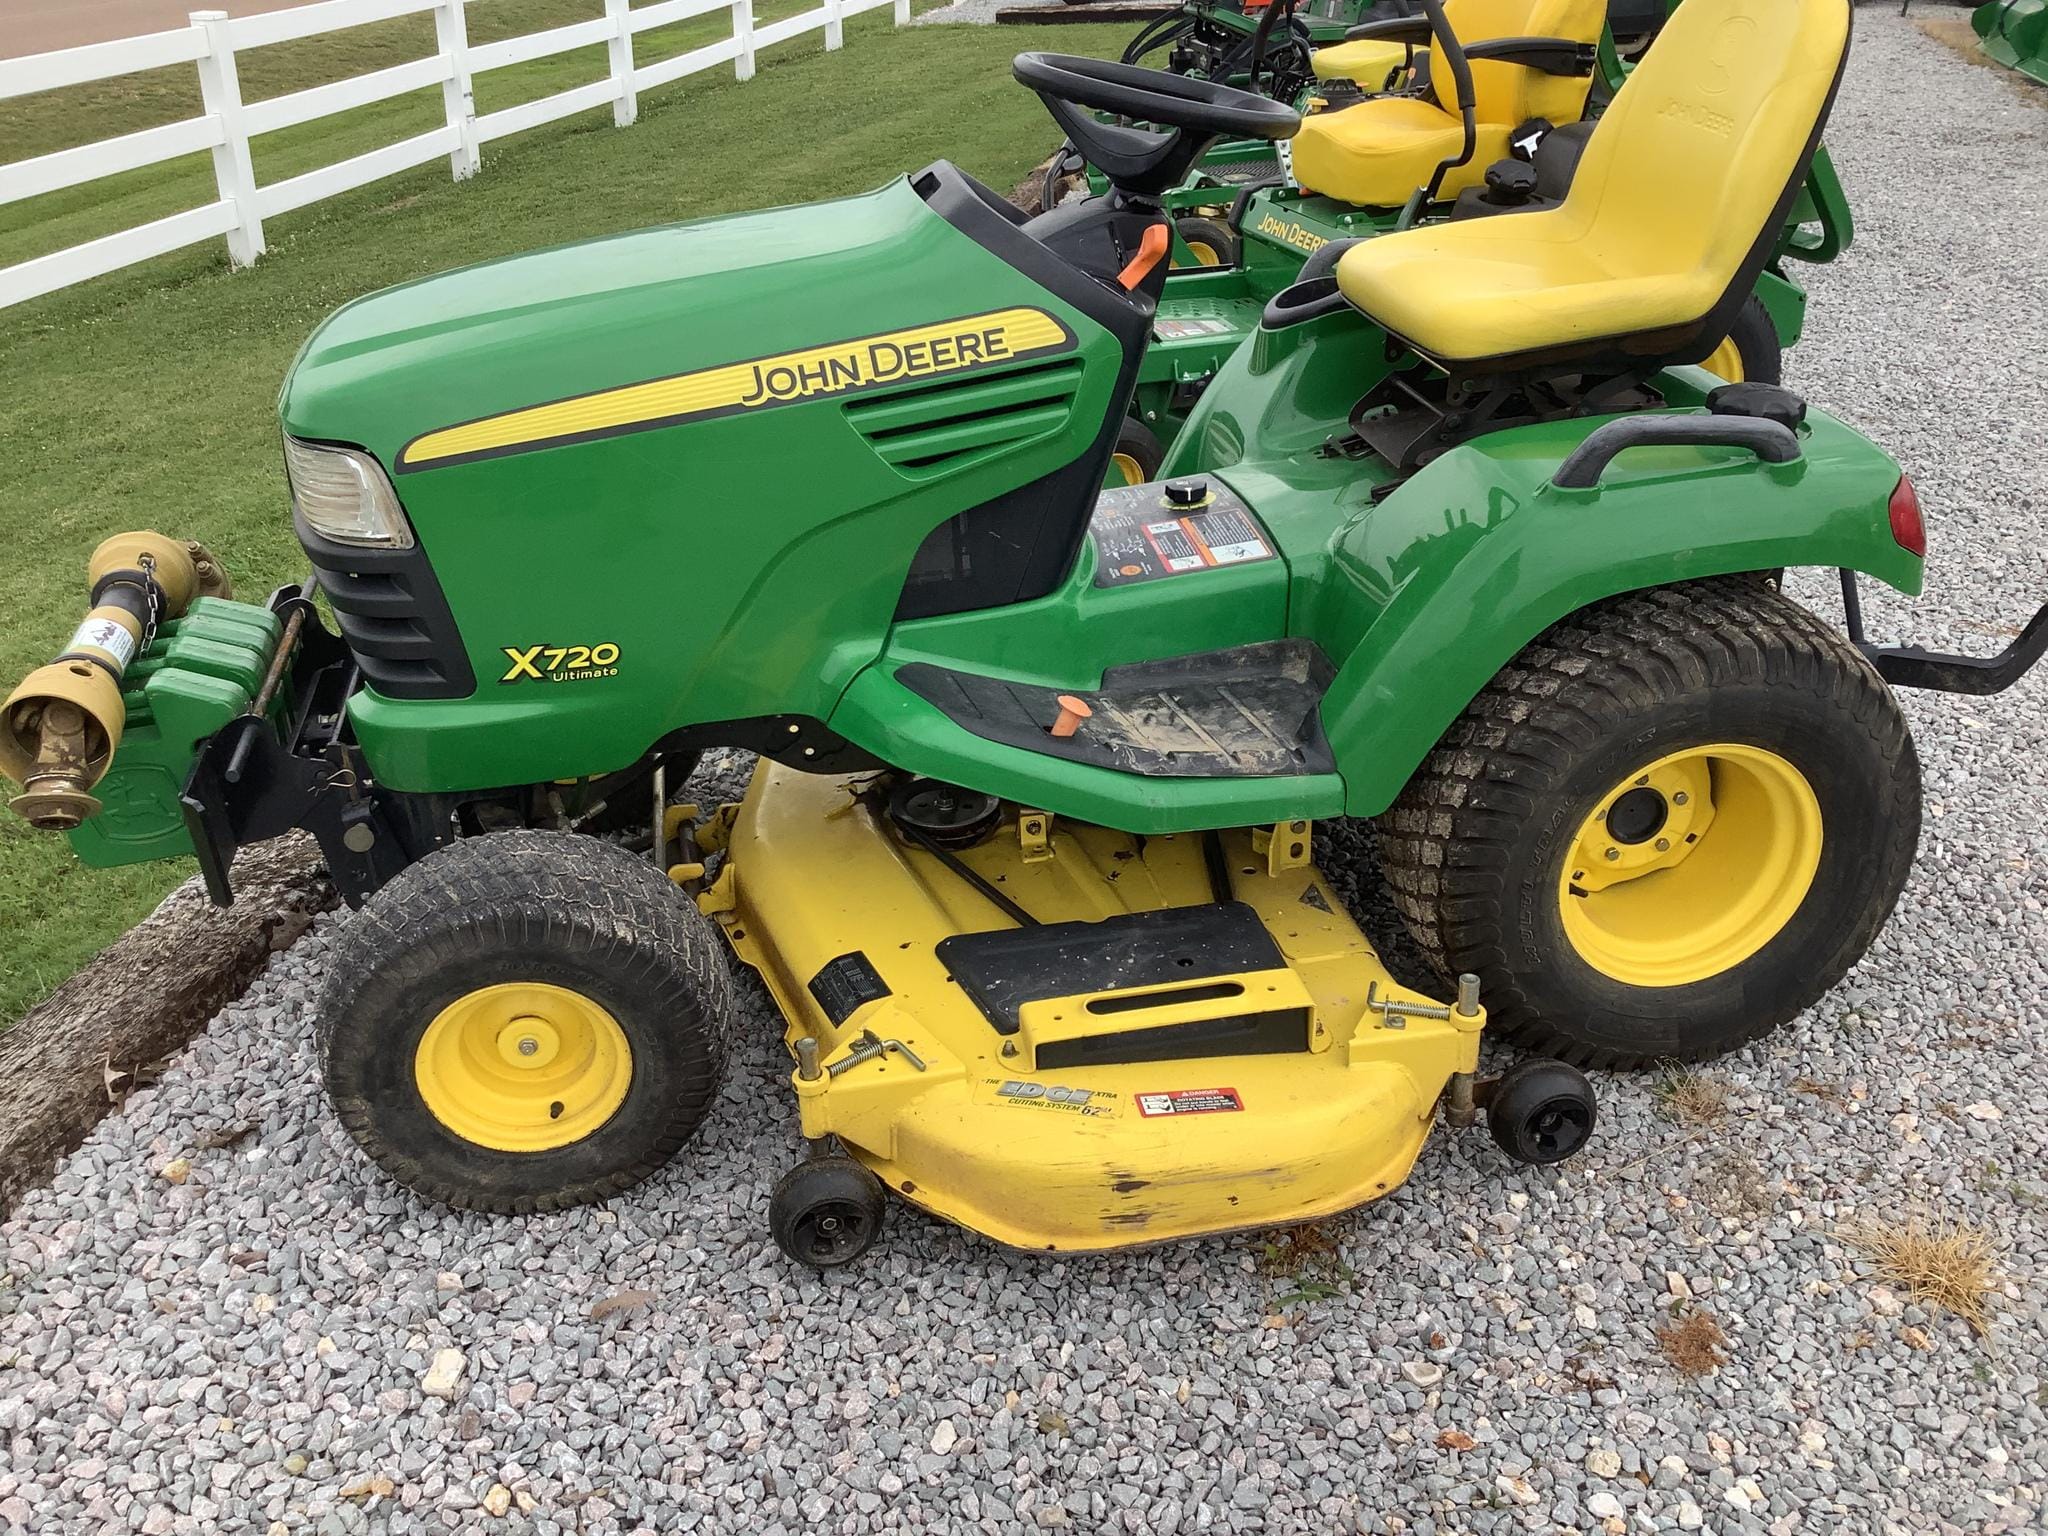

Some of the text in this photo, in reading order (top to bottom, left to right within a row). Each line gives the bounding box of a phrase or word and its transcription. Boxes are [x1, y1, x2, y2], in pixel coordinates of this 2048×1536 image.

[1257, 212, 1290, 240] JOHN
[742, 327, 1011, 403] JOHN DEERE
[500, 642, 621, 682] X720
[553, 667, 618, 682] Ultimate
[996, 1080, 1094, 1105] EDGE
[1095, 1091, 1118, 1099] XTRA
[1008, 1098, 1045, 1107] CUTTING
[1046, 1102, 1080, 1112] SYSTEM
